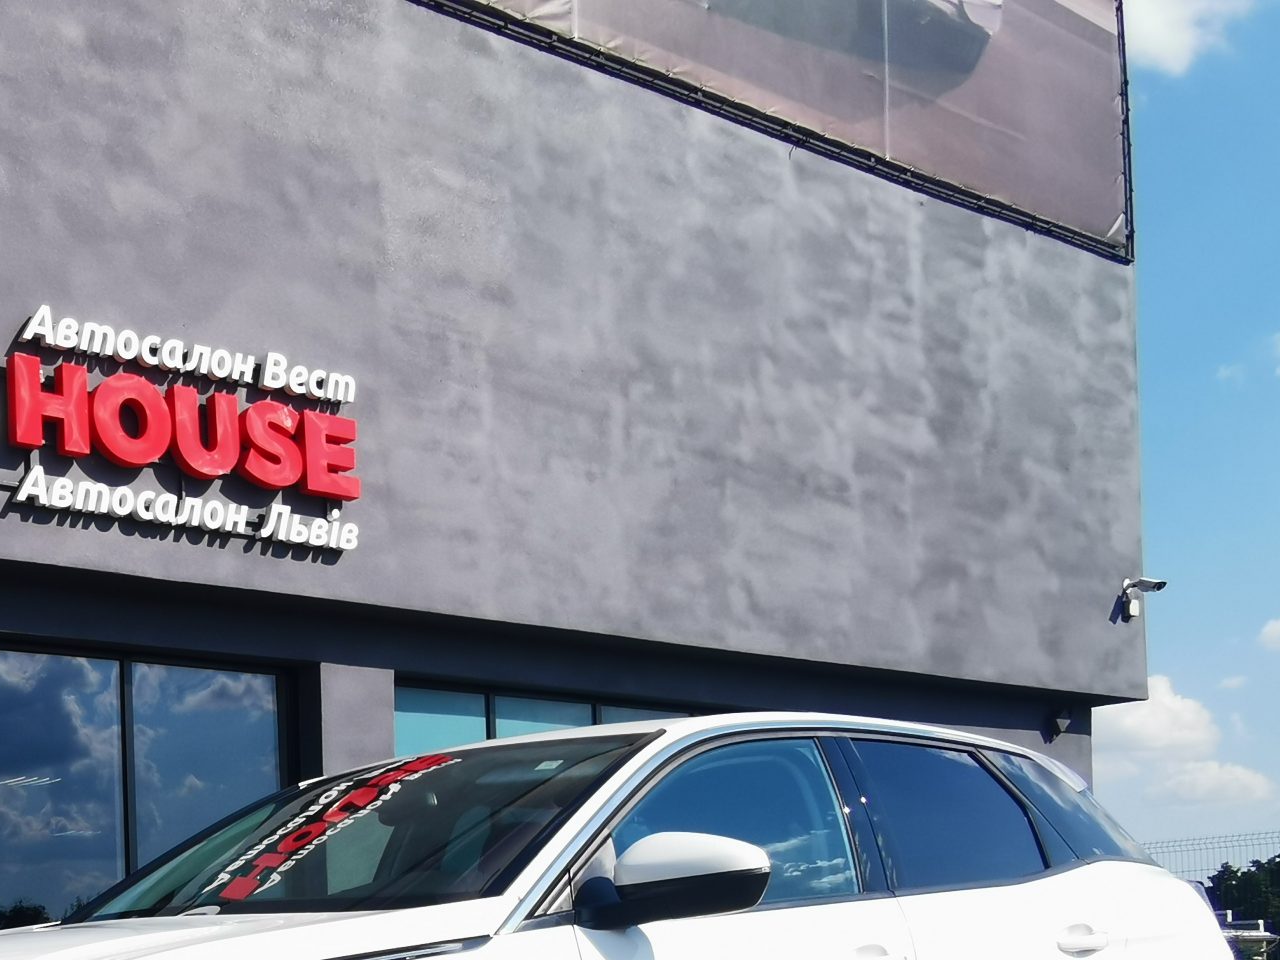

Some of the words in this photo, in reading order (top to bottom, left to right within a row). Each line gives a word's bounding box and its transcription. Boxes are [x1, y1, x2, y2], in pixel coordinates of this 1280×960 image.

[19, 304, 256, 384] Автосалон
[259, 351, 356, 404] Вест
[6, 352, 361, 501] HOUSE
[15, 465, 249, 535] Автосалон
[256, 503, 360, 551] Львів
